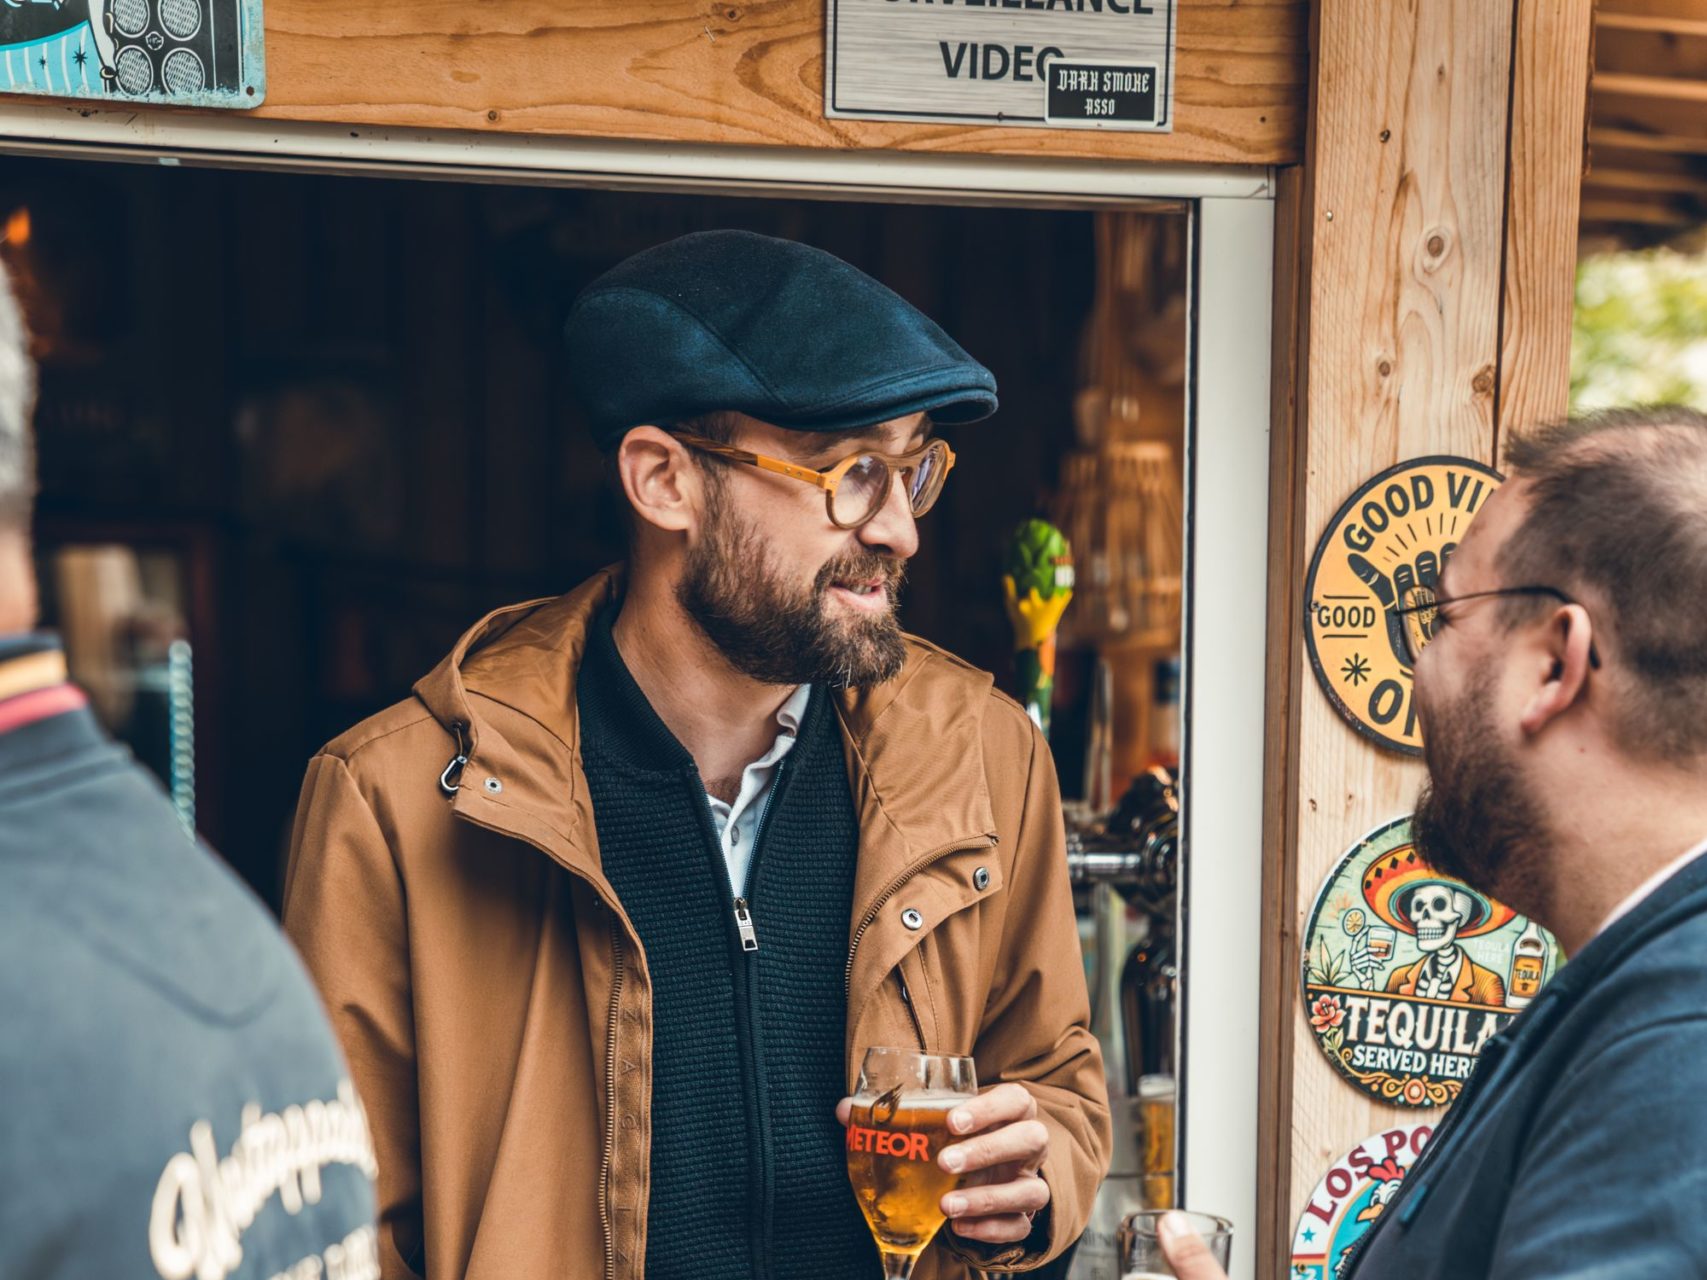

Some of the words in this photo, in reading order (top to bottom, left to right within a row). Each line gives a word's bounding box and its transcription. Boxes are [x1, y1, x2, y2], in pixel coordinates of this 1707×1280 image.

[1057, 69, 1099, 92] DARK
[1103, 71, 1150, 93] SMOKE
[1084, 98, 1116, 116] ASSO
[1343, 474, 1434, 553] GOOD
[1446, 471, 1494, 514] VI
[1317, 606, 1376, 628] GOOD
[1345, 995, 1498, 1055] TEQUILA
[1352, 1045, 1427, 1076] SERVED
[1305, 1145, 1375, 1227] LOS
